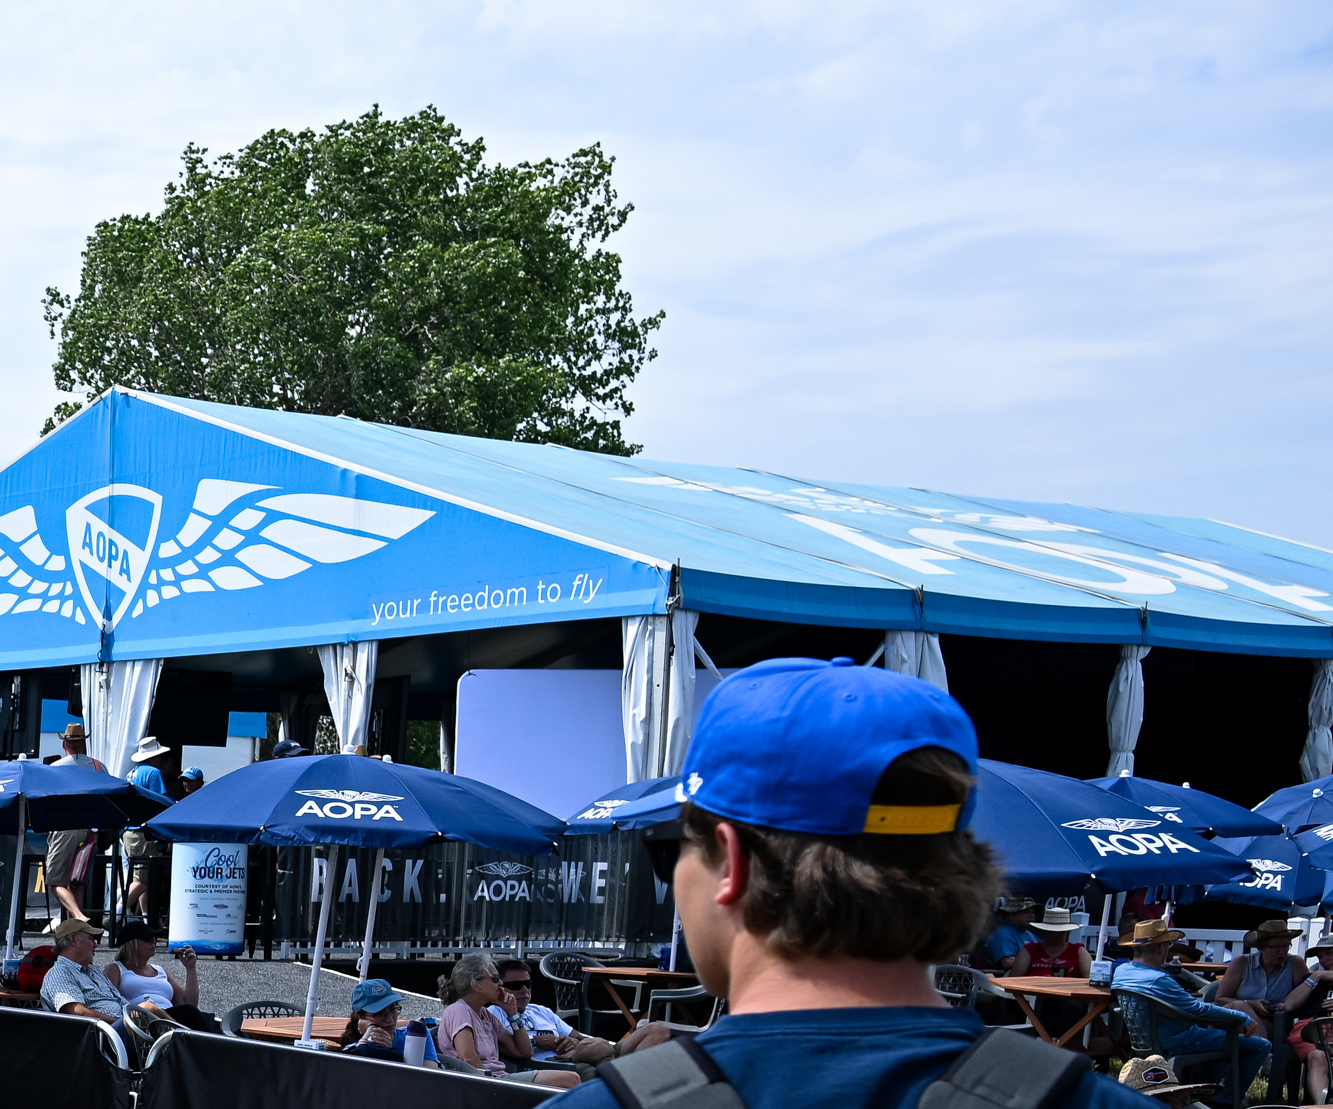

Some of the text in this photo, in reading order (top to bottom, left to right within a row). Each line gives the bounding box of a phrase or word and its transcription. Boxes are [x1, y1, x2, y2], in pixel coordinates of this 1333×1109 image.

[82, 521, 132, 583] AOPA
[371, 573, 603, 626] your freedom to fly
[294, 800, 404, 822] AOPA
[1087, 832, 1201, 857] AOPA
[204, 847, 240, 869] Cool
[192, 867, 246, 880] YOUR JETS
[1239, 872, 1283, 891] OPA
[473, 880, 531, 902] AOPA
